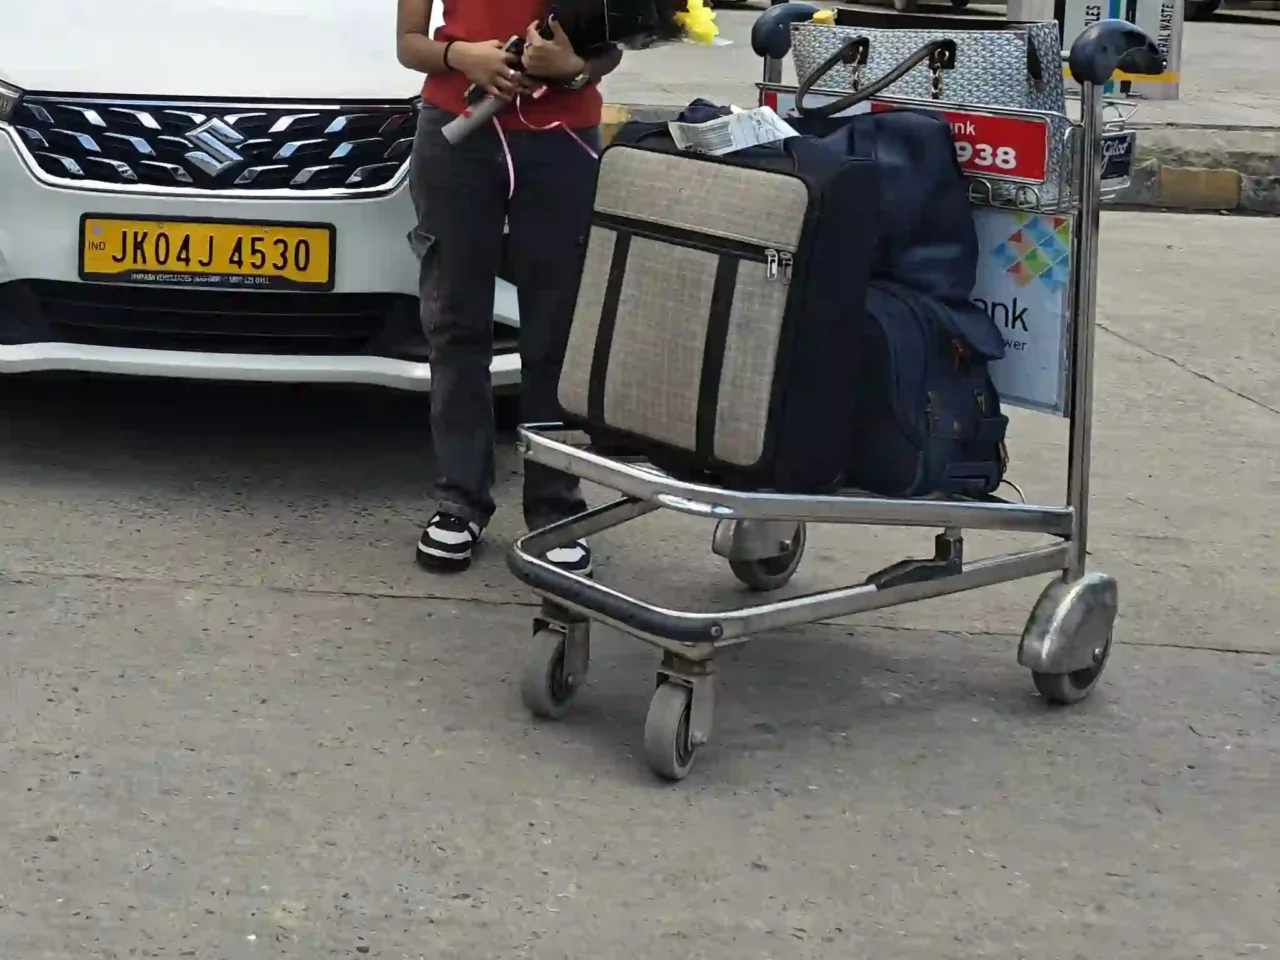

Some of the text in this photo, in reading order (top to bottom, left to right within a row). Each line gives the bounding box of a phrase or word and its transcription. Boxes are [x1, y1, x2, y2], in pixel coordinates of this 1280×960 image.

[1160, 3, 1174, 32] WASTE
[950, 120, 976, 136] nk
[953, 141, 1018, 170] 938
[87, 230, 311, 272] IND JK04J 4530
[972, 296, 1029, 333] nk
